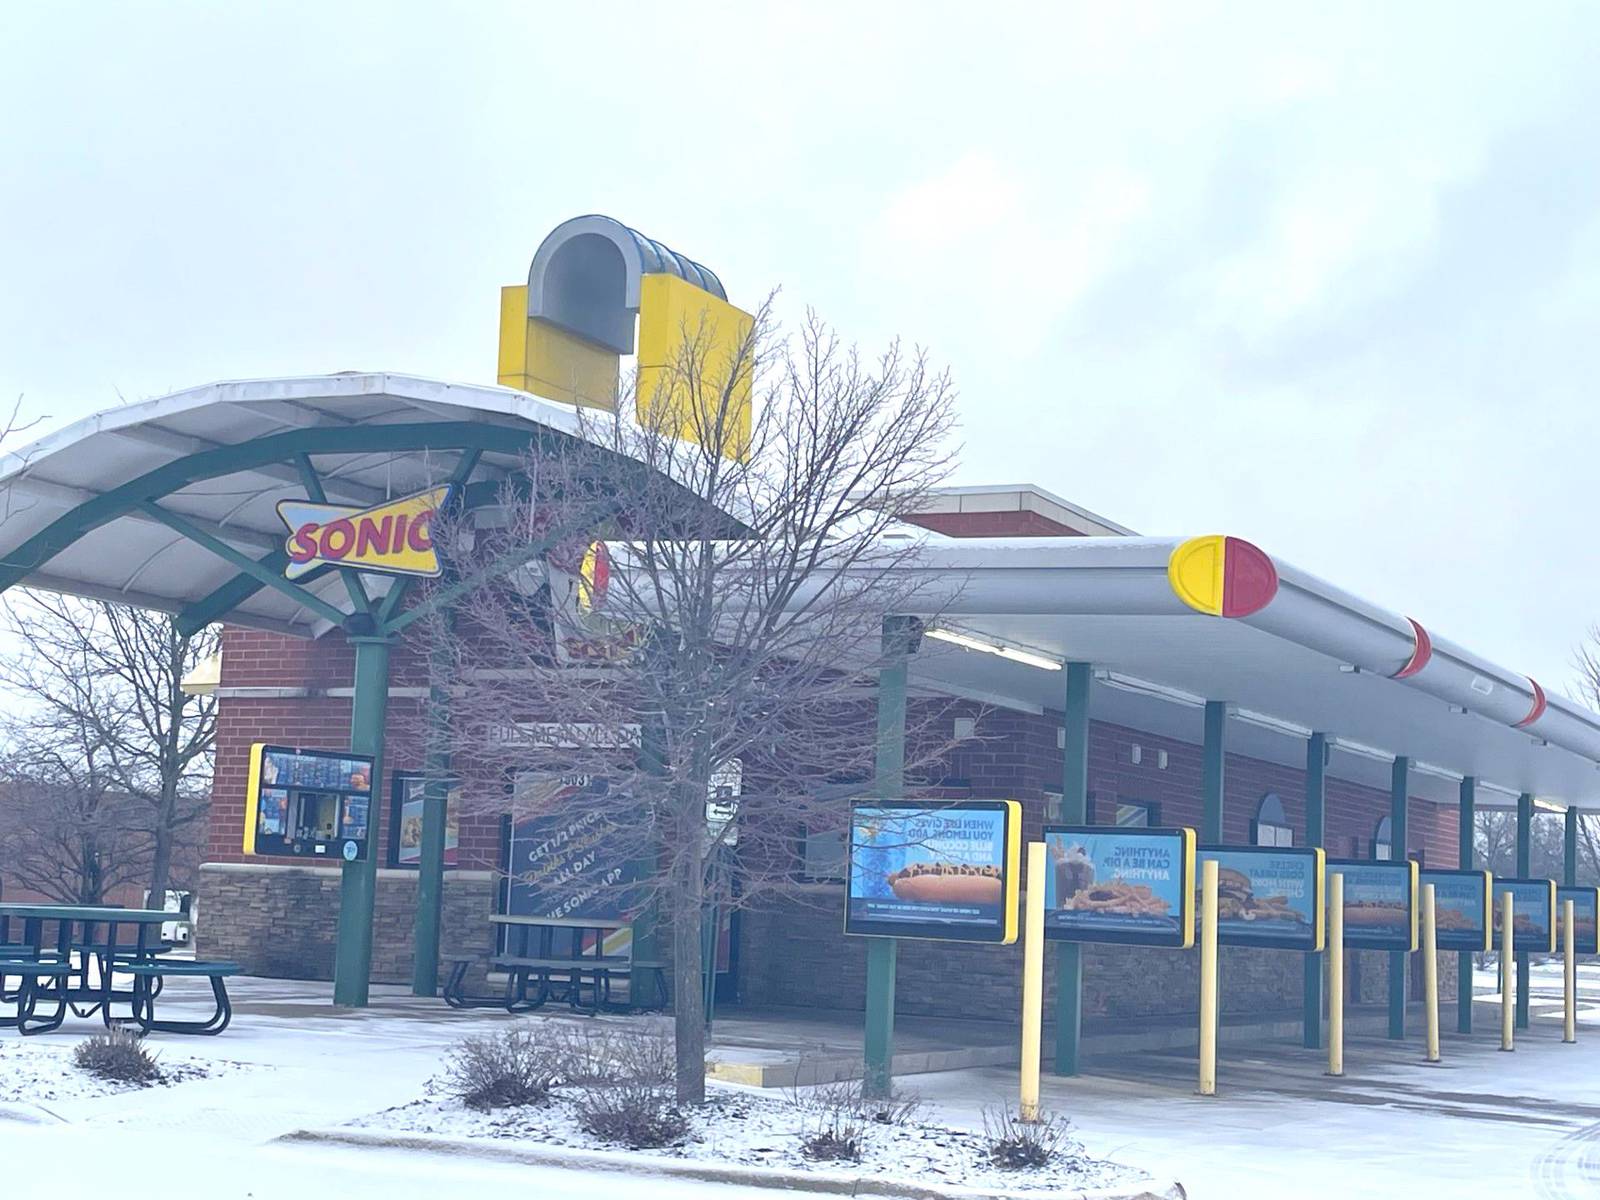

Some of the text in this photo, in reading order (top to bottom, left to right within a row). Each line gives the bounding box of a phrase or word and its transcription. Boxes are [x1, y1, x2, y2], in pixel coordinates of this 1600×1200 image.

[288, 509, 434, 565] SONIC
[528, 841, 550, 862] GET
[573, 850, 596, 873] DAY
